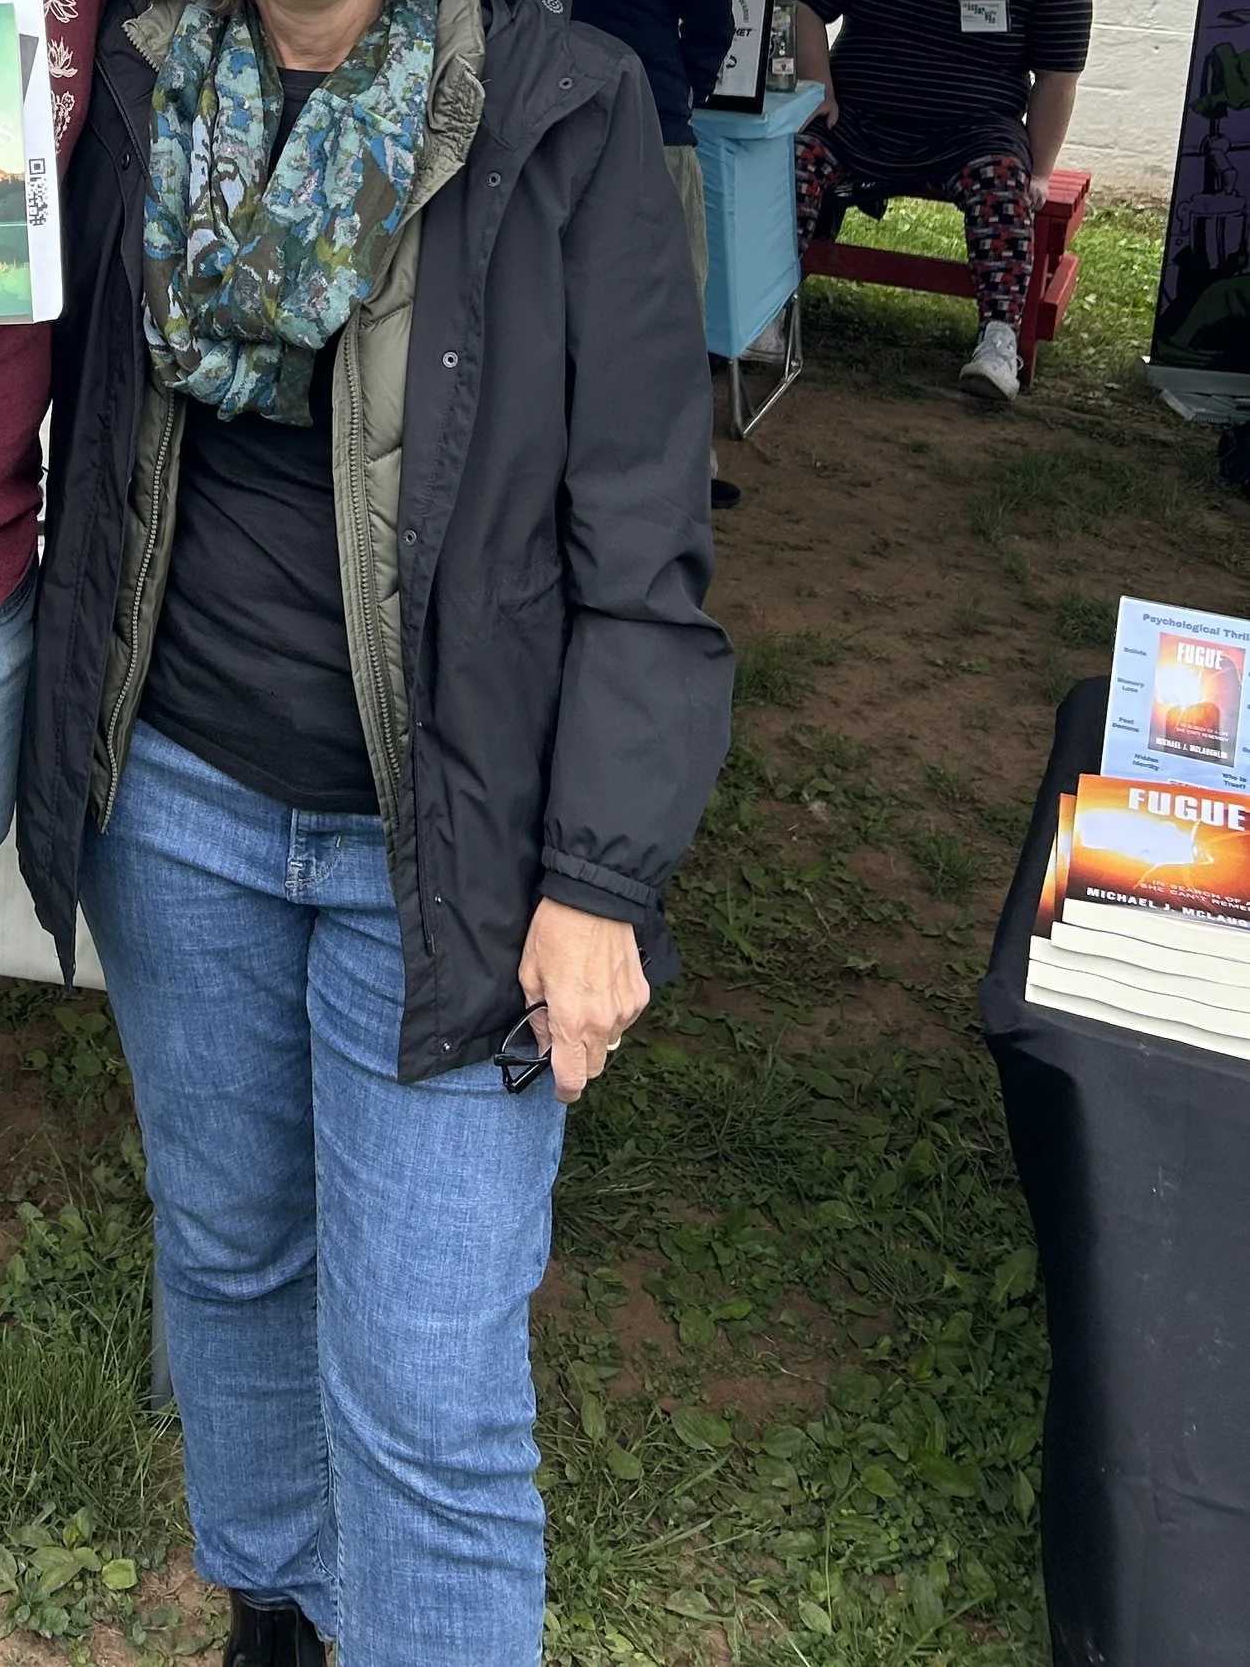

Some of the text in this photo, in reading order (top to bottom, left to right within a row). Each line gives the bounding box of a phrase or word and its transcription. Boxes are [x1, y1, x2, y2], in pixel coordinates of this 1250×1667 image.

[1143, 614, 1250, 641] Psychological Thril
[1176, 642, 1225, 670] FUGUE
[1128, 787, 1246, 832] FUGUE
[1086, 887, 1250, 927] MICHAEL J. MCLAUG
[1140, 882, 1250, 912] SHE CAN'T REME
[1170, 884, 1221, 900] SEARCH
[1224, 896, 1242, 904] OF
